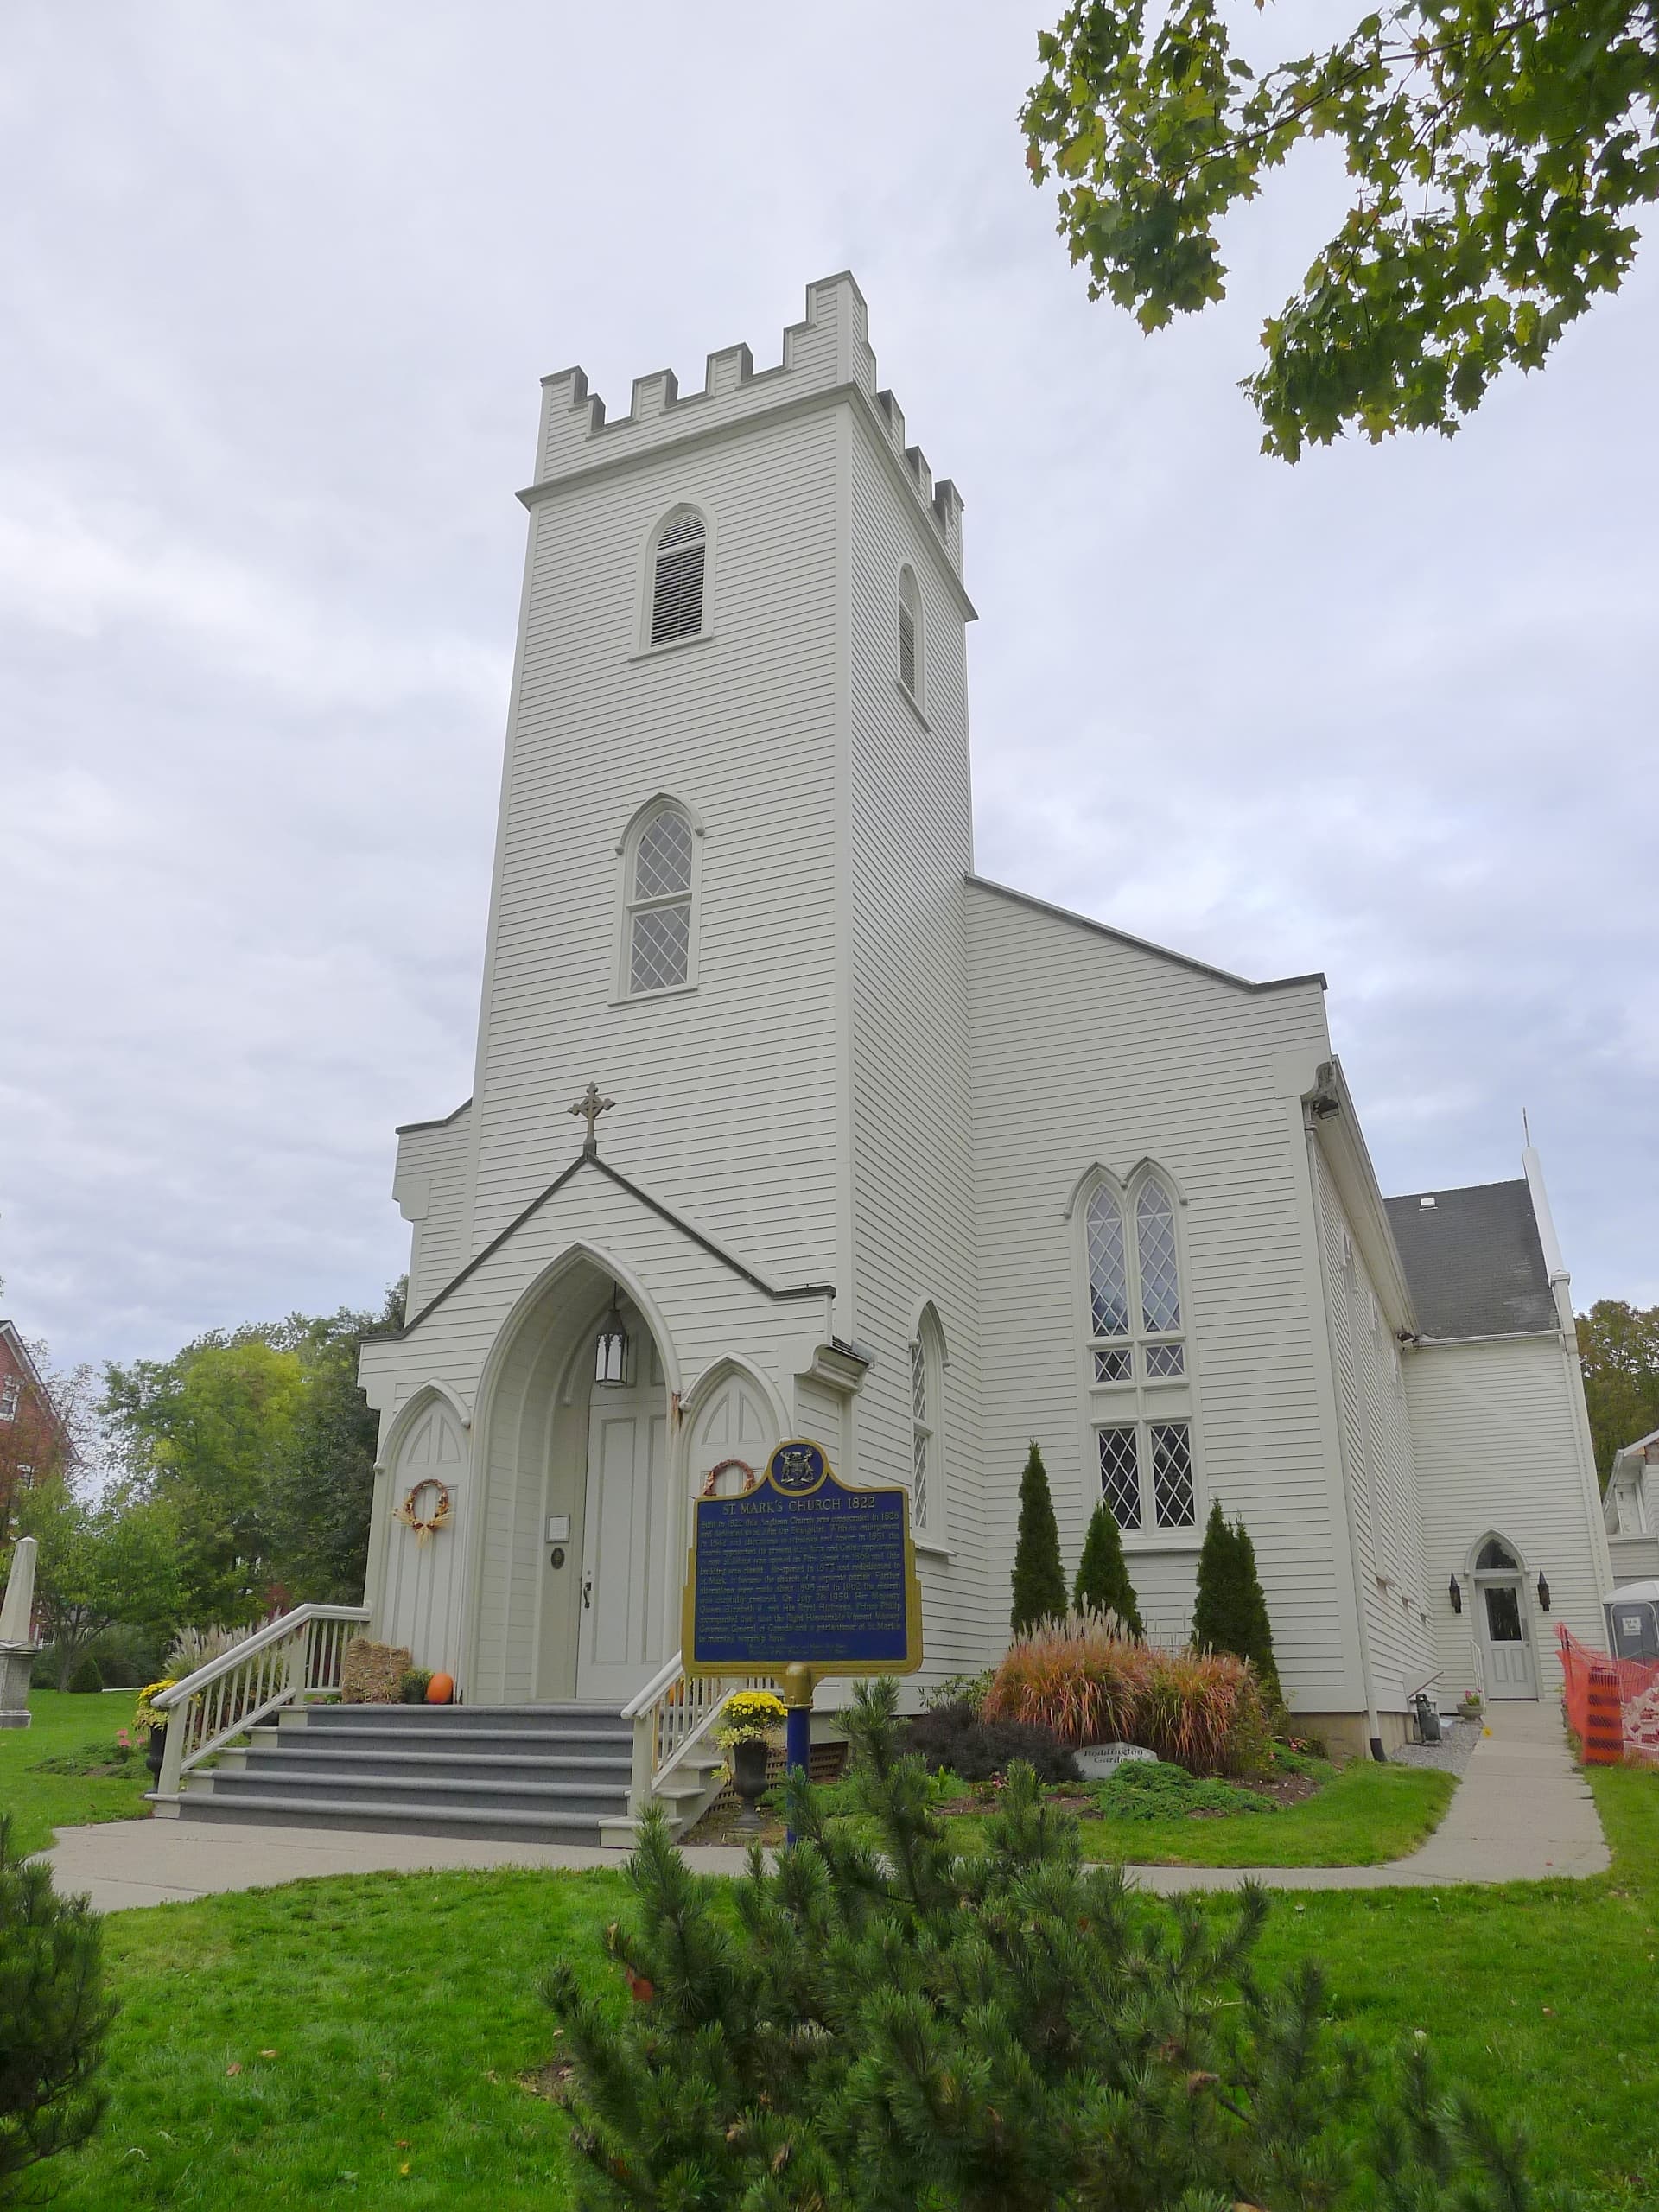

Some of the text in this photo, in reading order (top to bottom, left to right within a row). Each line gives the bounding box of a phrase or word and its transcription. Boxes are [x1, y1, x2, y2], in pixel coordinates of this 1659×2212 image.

[741, 1500, 783, 1514] MARK'S
[788, 1499, 841, 1511] CHURCH
[848, 1497, 875, 1509] 1822
